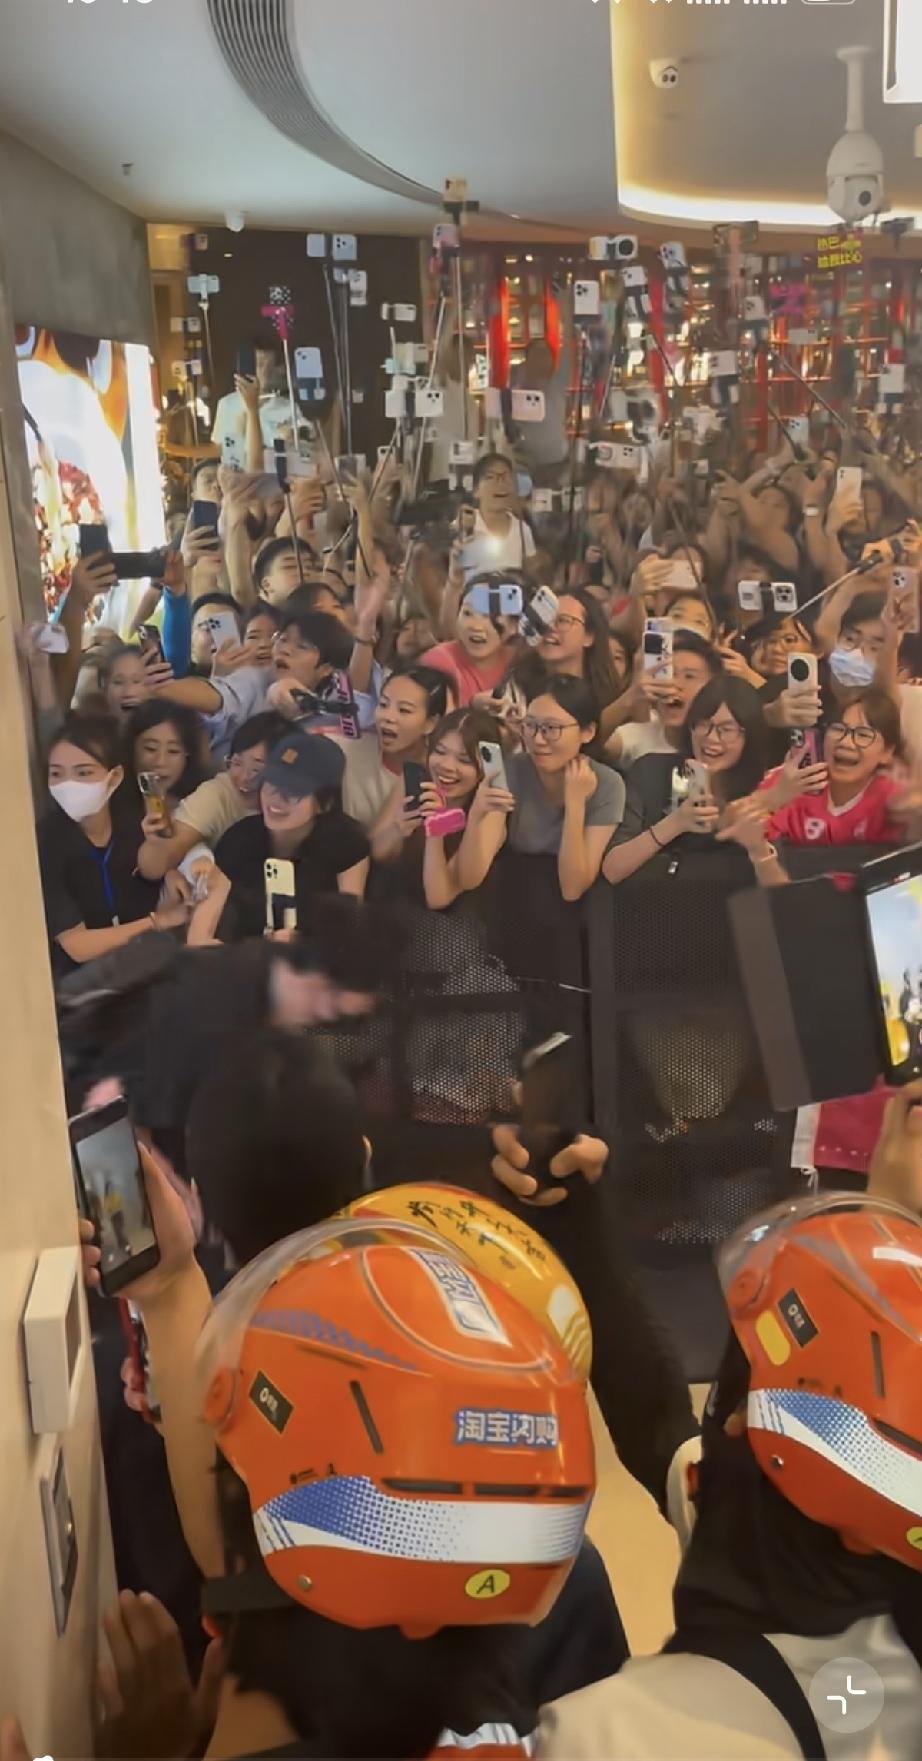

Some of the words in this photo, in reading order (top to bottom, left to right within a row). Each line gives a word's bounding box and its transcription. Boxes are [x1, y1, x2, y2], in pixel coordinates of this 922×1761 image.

[456, 1409, 560, 1446] 淘宝闪购
[476, 1574, 495, 1595] A
